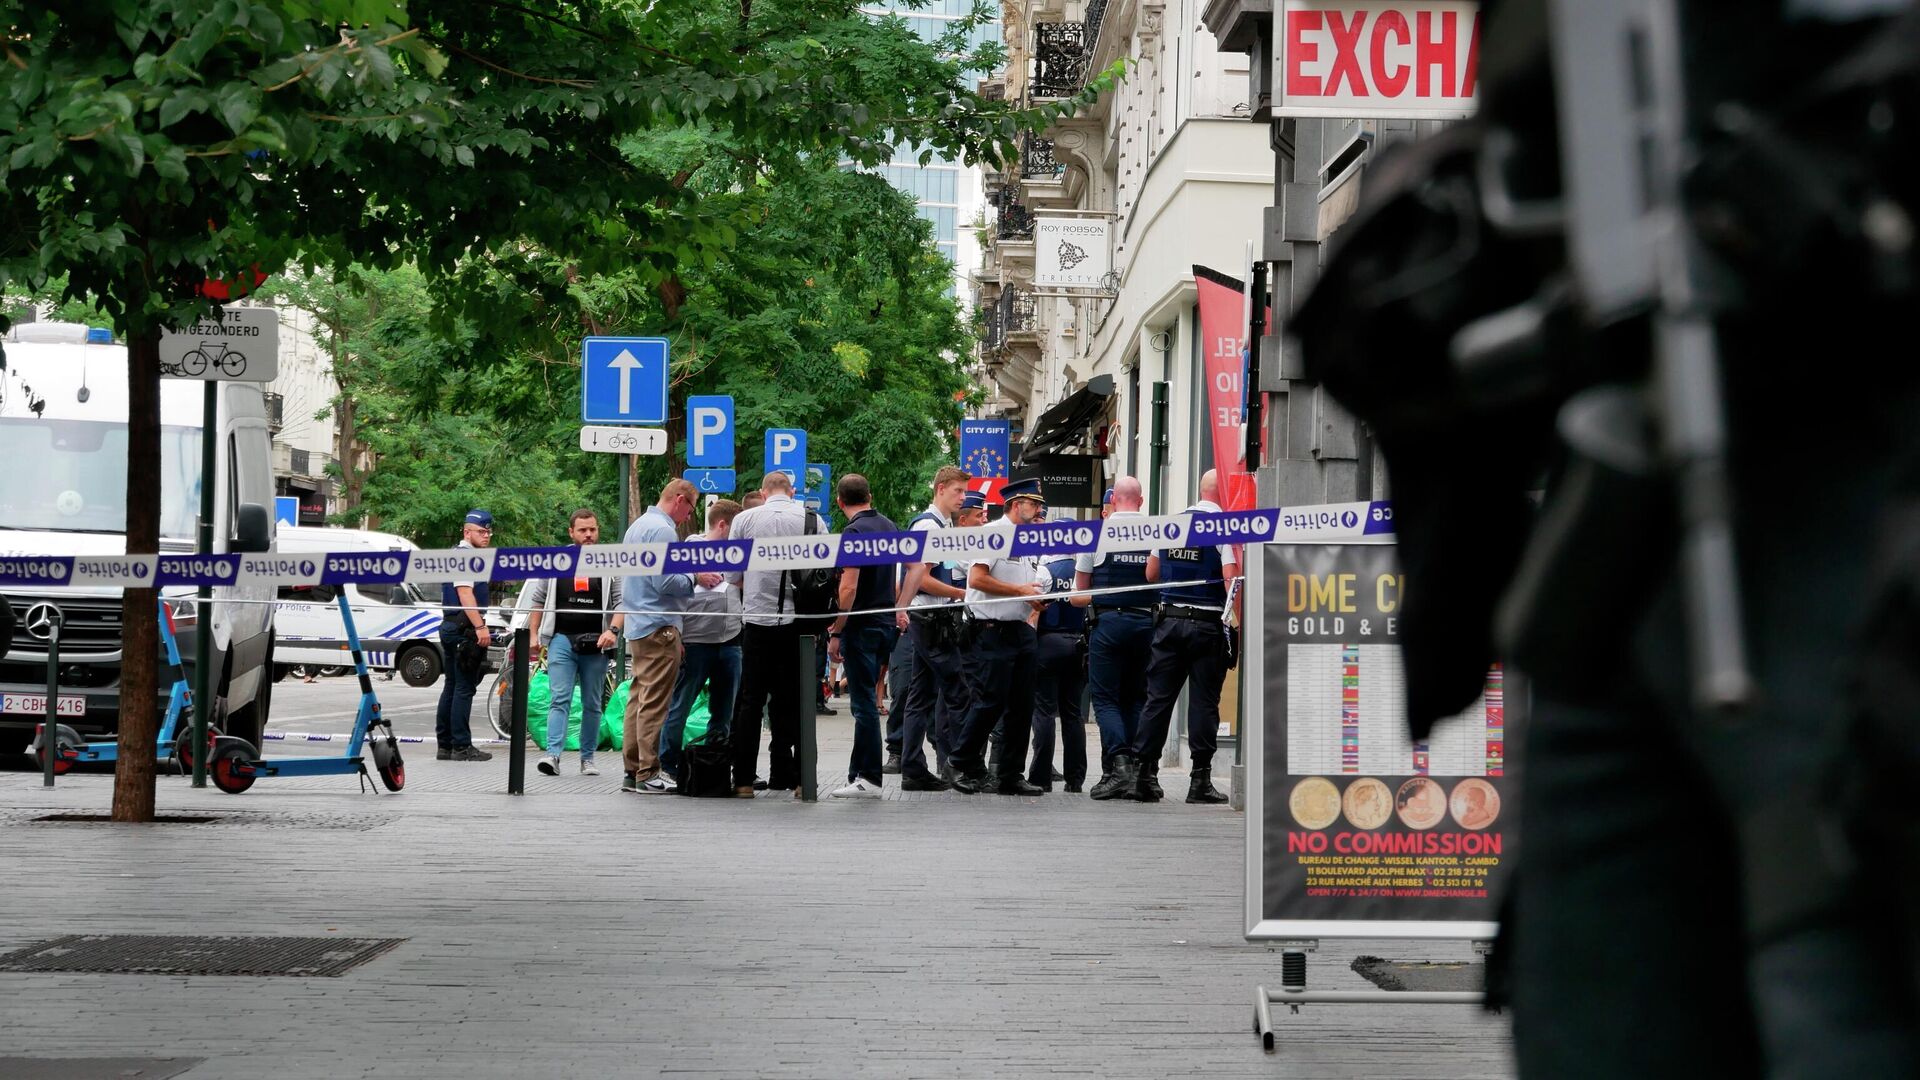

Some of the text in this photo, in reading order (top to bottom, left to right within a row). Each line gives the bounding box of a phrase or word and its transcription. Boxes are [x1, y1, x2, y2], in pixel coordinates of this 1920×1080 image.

[1041, 224, 1105, 234] ROY ROBSON
[693, 407, 727, 457] P
[965, 427, 1006, 435] CITY GIFT
[773, 433, 798, 466] P
[1043, 475, 1089, 483] L'ADRESSE
[1194, 517, 1250, 536] Police
[1283, 511, 1338, 530] Politie
[1018, 528, 1074, 547] Police
[1107, 523, 1160, 542] Politie
[843, 537, 898, 557] Police
[932, 533, 984, 552] Politie
[585, 552, 637, 569] Politie
[670, 546, 725, 566] Police
[758, 543, 810, 561] Politie
[1113, 554, 1149, 564] POLIC
[1168, 548, 1200, 562] POLITIE
[80, 561, 130, 578] Politie
[161, 561, 214, 578] Police
[245, 560, 296, 577] Politie
[329, 558, 381, 576] Police
[414, 557, 465, 574] Politie
[499, 554, 554, 571] Police
[1056, 578, 1074, 590] Pol
[1287, 573, 1357, 613] DME
[1376, 573, 1405, 613] C
[1287, 616, 1345, 636] GOLD
[1359, 618, 1372, 636] &
[1287, 831, 1503, 855] NO COMMISSION
[1298, 856, 1332, 865] BUREAU
[1332, 856, 1343, 865] DE
[1344, 856, 1380, 865] CHANGE
[1416, 857, 1458, 866] KANTOOR
[1465, 857, 1499, 866] CAMBIO
[1307, 867, 1488, 876] 11 BOULEVARD ADOLPHE MAX 02 218 22 94
[1306, 876, 1484, 887] 23 RUE MARCHÉ AUX HERBES 02 513 01 16
[1307, 888, 1330, 897] OPEN
[1332, 888, 1347, 897] 7/7
[1357, 888, 1378, 897] 24/7
